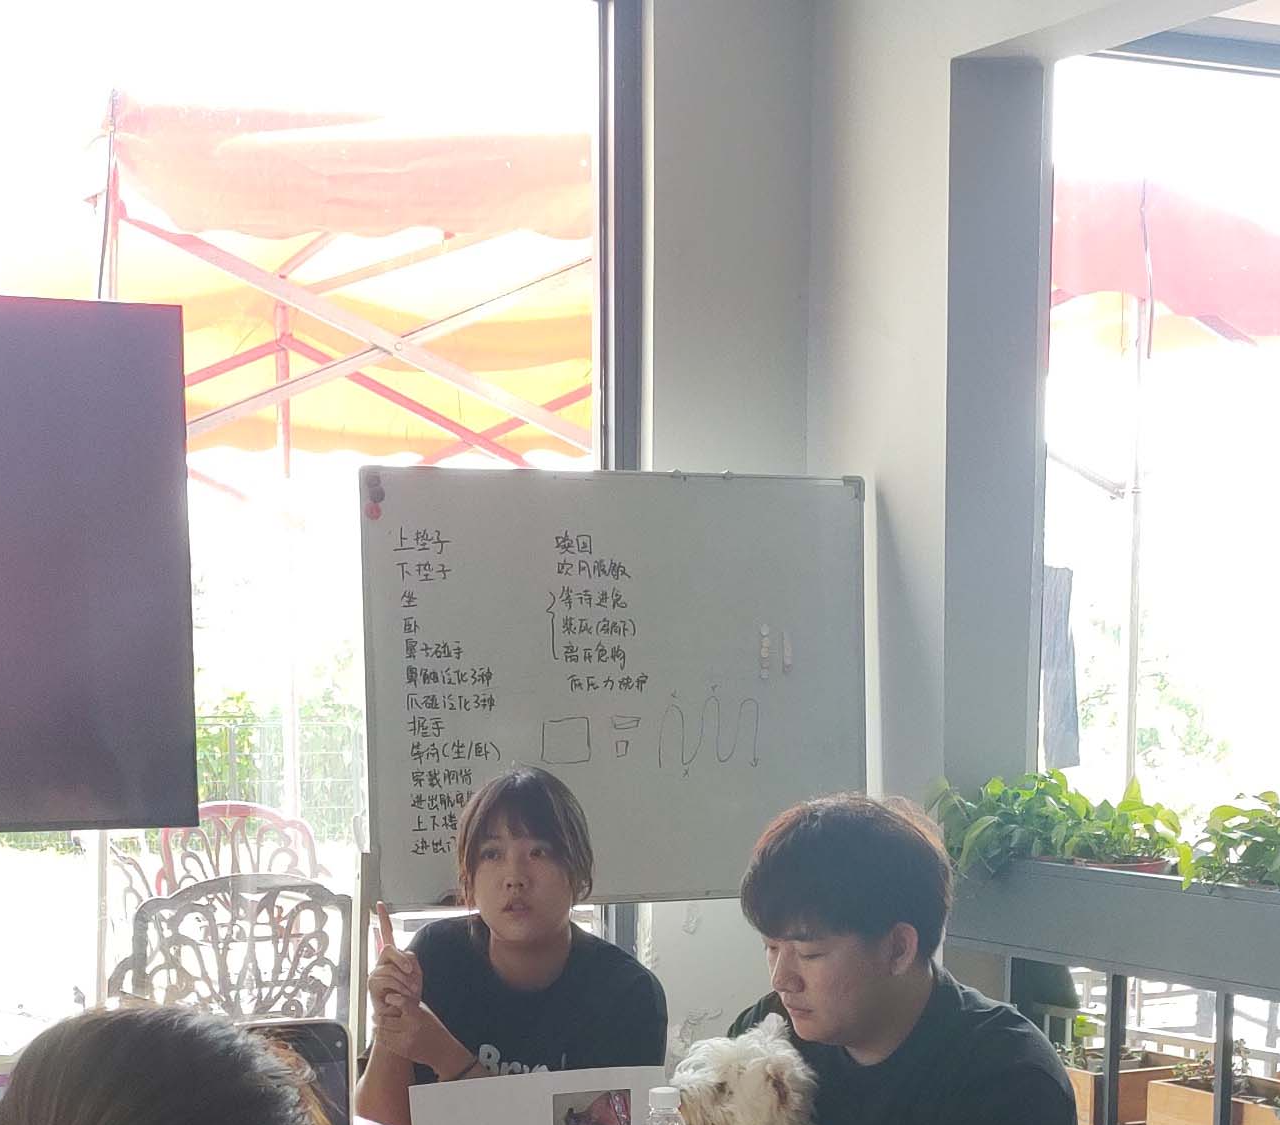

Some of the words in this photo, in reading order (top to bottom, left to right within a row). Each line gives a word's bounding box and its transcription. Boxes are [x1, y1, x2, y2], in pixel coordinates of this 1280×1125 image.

[393, 526, 452, 555] 上垫子
[555, 530, 592, 555] 唤回
[396, 561, 452, 582] 下垫子
[401, 590, 418, 608] 坐
[403, 616, 420, 635] 卧
[405, 639, 463, 660] 鼻子碰手
[407, 716, 445, 738] 握手
